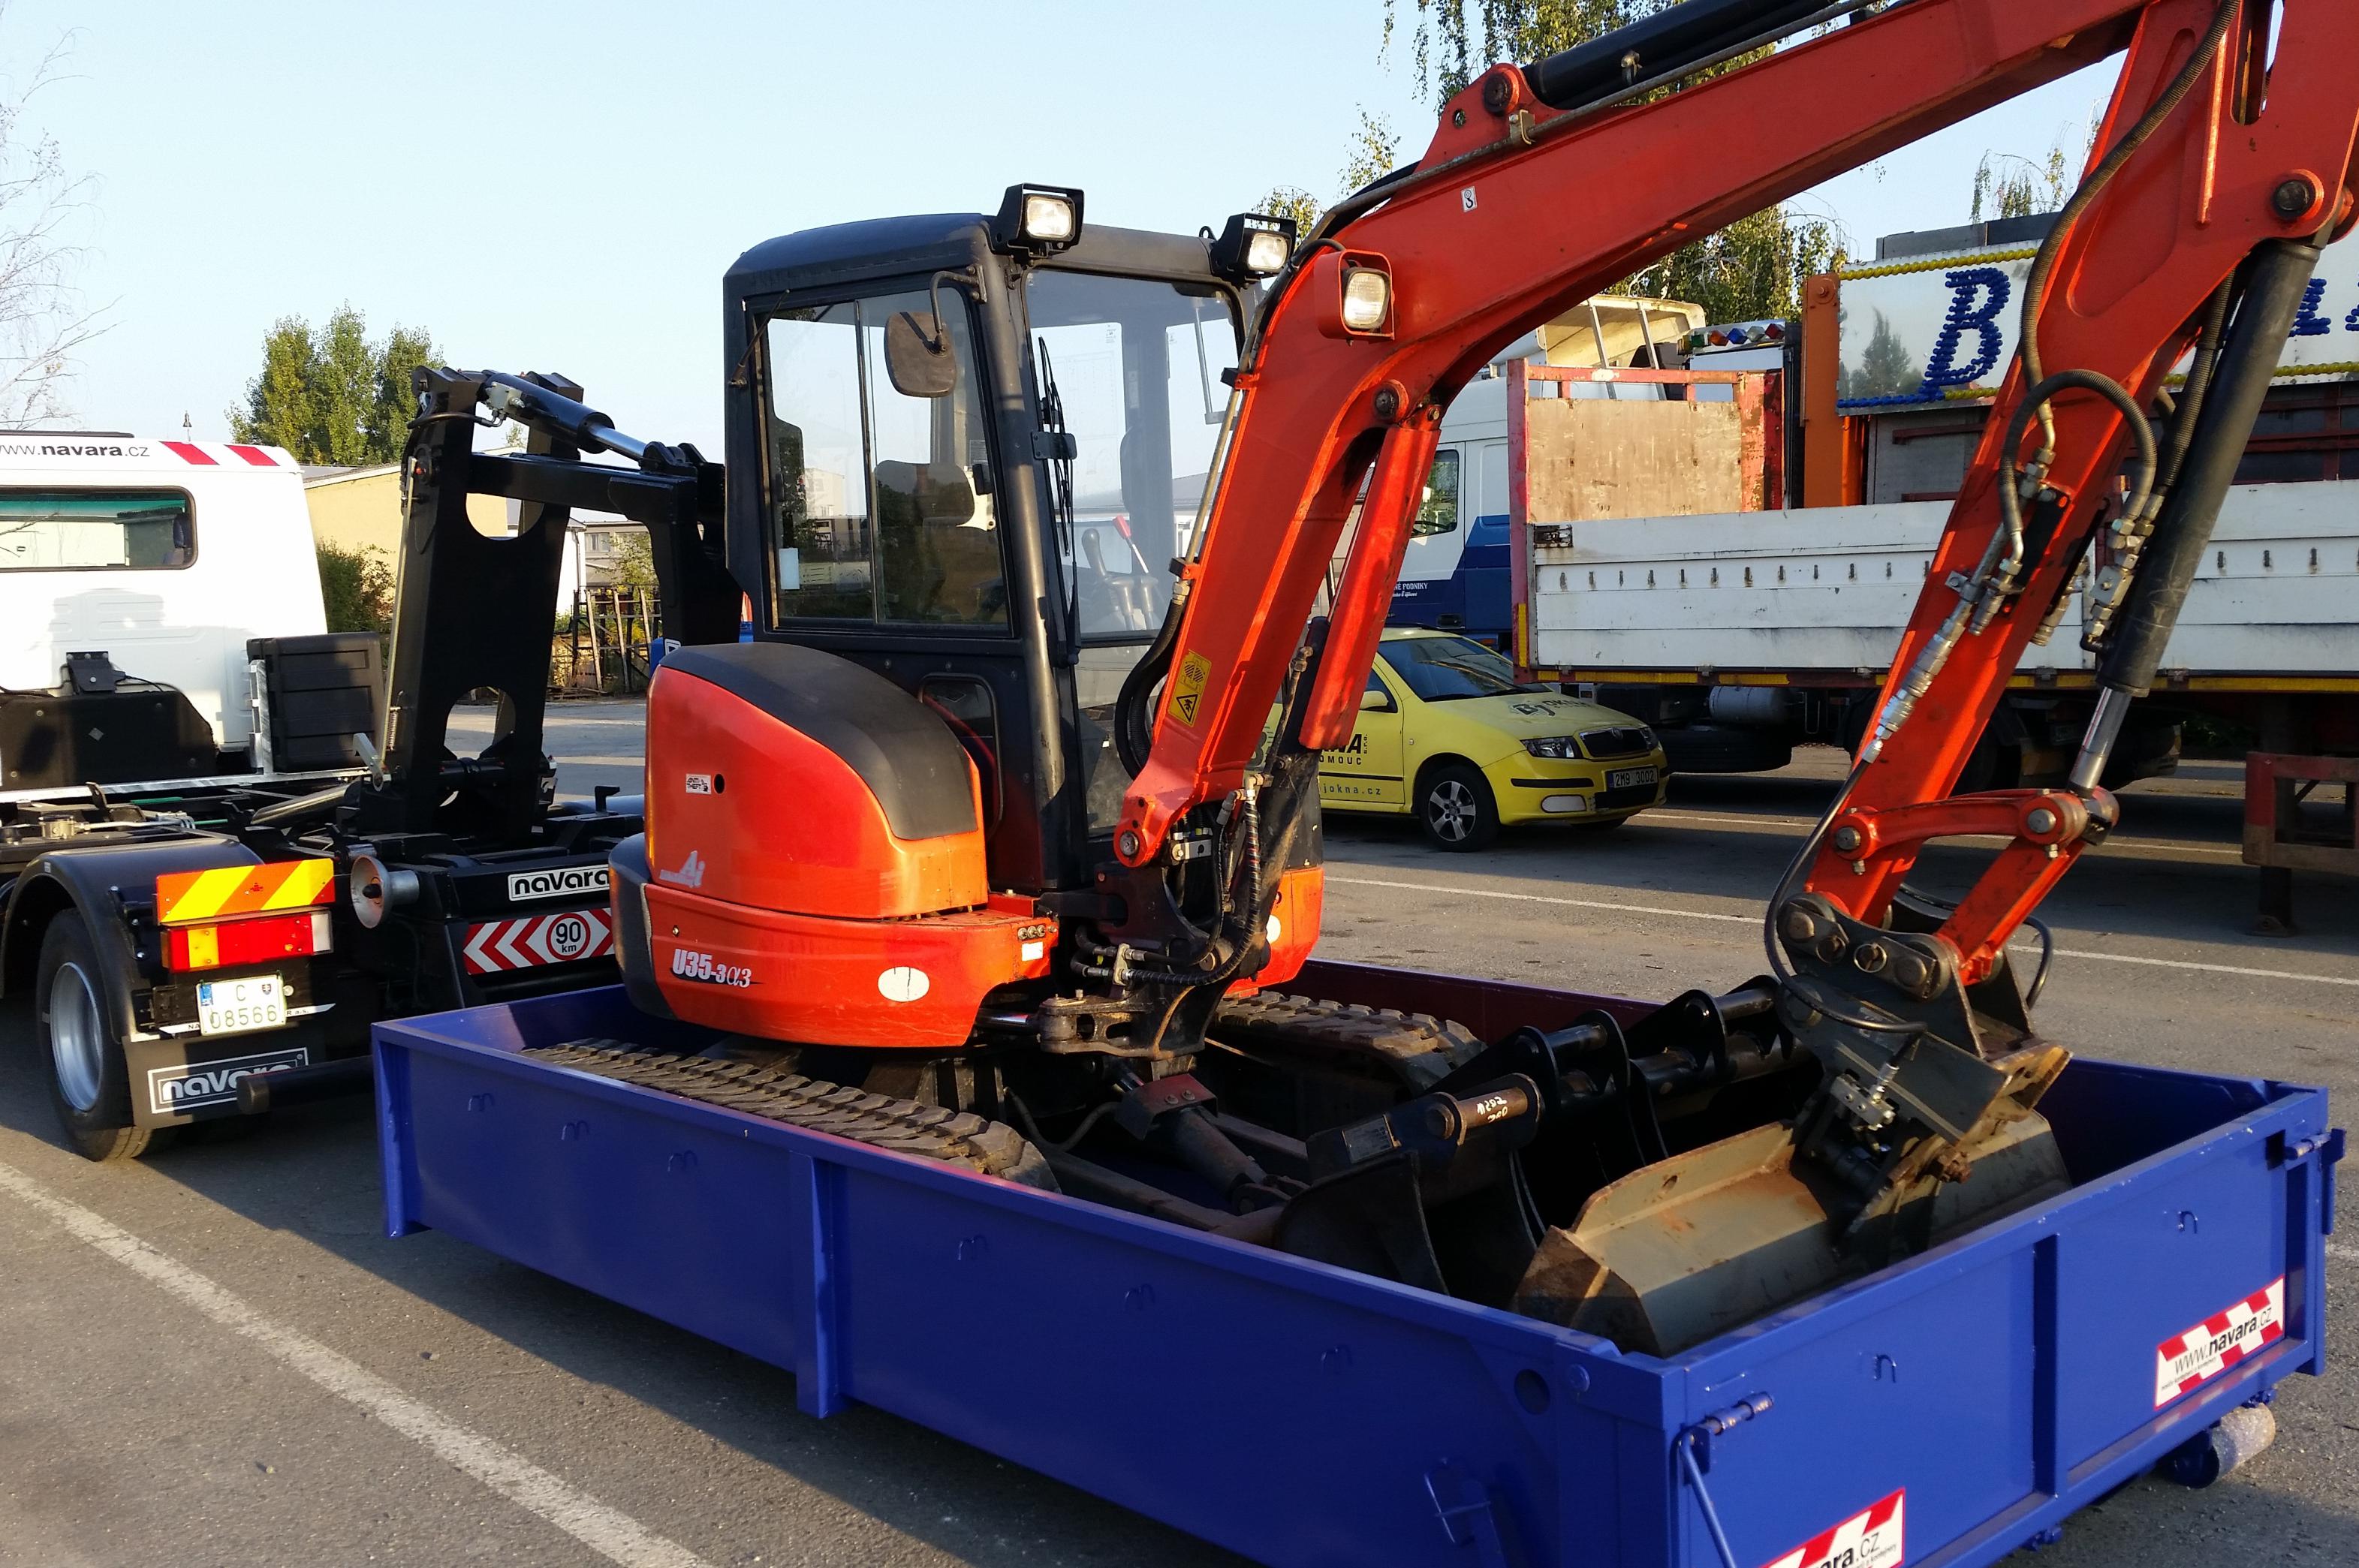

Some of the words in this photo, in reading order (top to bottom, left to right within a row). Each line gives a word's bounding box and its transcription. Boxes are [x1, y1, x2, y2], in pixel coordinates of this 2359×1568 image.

[0, 444, 150, 457] ww.navara.cz
[1616, 772, 1630, 787] 2M9
[1636, 770, 1654, 784] 3002
[514, 870, 610, 895] navara
[556, 921, 581, 944] 90
[562, 944, 577, 953] km
[236, 984, 246, 1002] C
[209, 1004, 278, 1029] 08566
[2174, 1307, 2272, 1374] www.navara.cz
